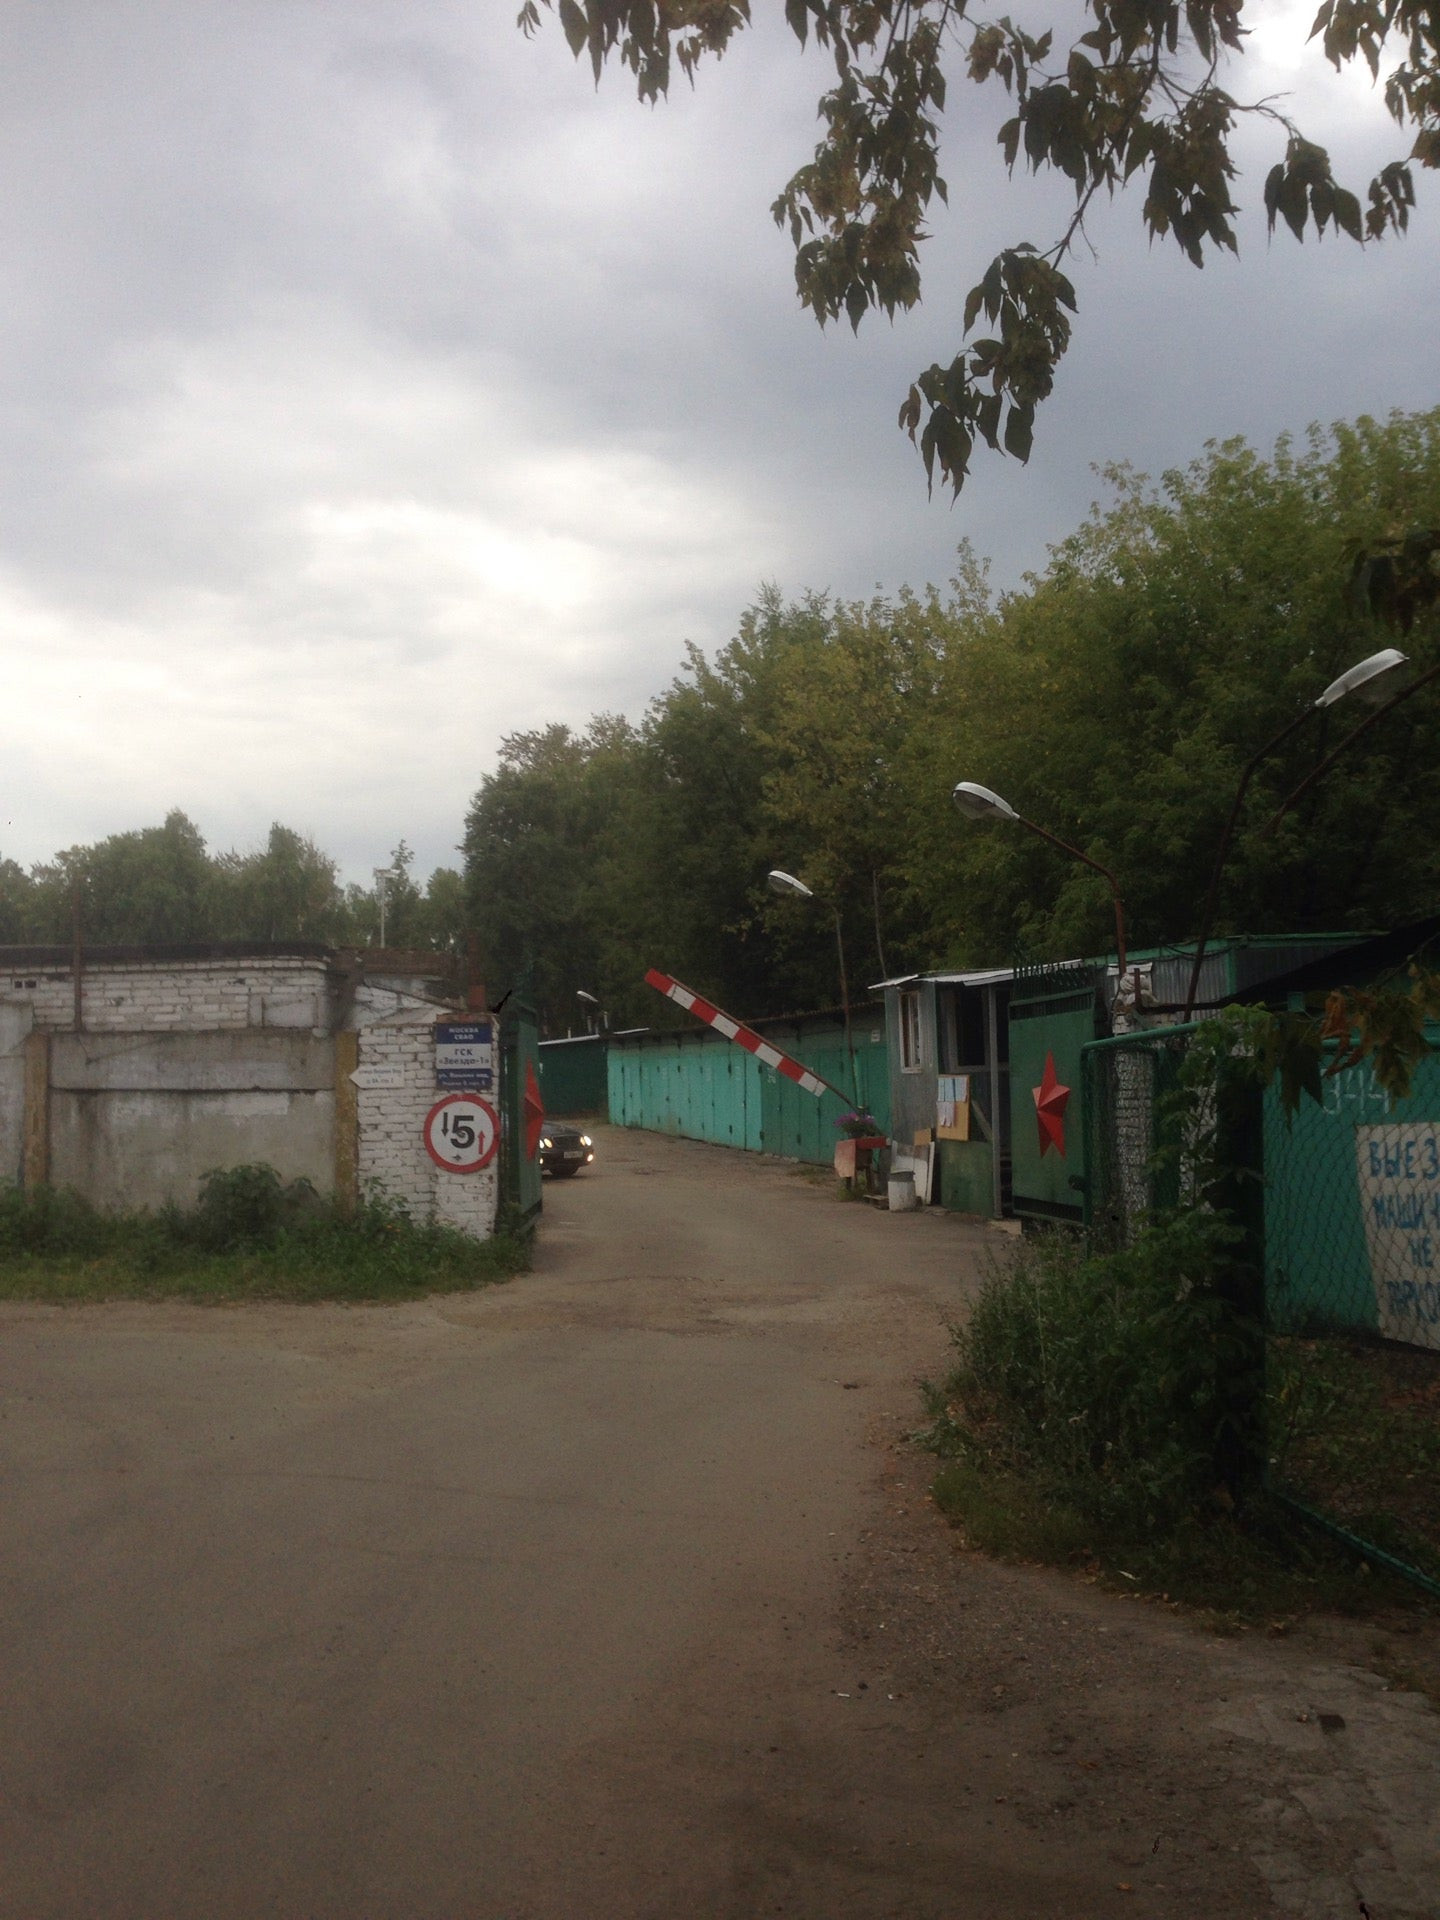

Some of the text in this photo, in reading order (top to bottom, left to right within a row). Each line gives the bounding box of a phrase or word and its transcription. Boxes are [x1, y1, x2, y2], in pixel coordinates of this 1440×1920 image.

[454, 1048, 473, 1056] ГСК
[450, 1115, 475, 1149] 5
[1411, 1235, 1433, 1268] НЕ
